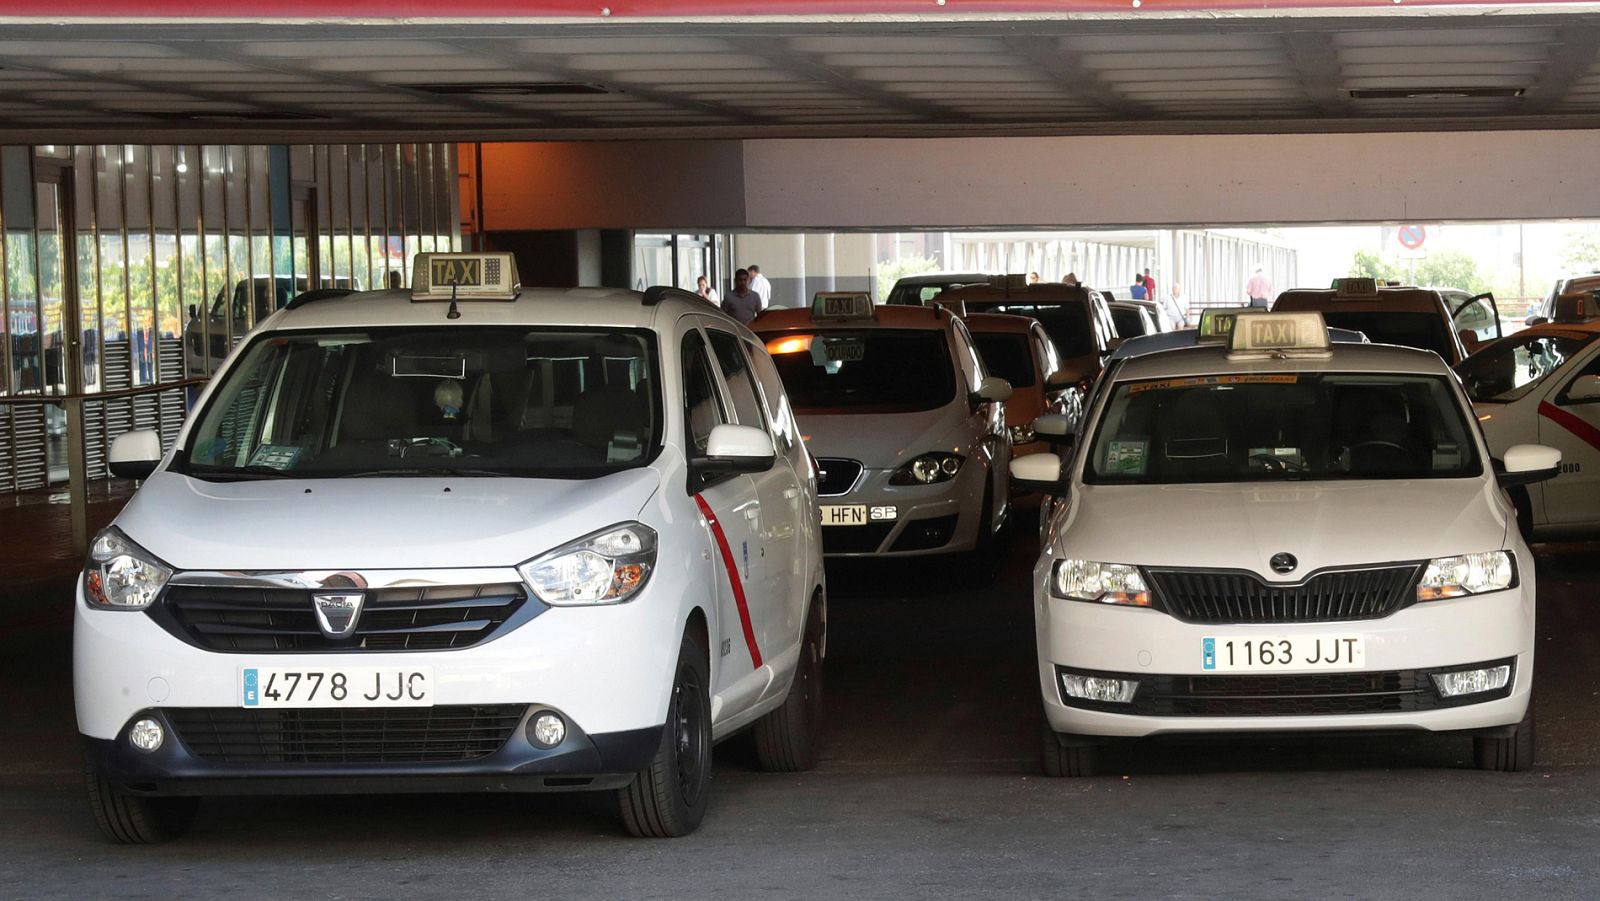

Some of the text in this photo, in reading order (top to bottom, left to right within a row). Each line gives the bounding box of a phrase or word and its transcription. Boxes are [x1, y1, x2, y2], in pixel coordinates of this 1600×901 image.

[432, 260, 479, 285] TAXI
[826, 299, 853, 314] TAXI
[1216, 316, 1232, 333] TA
[1252, 323, 1294, 345] TAXI
[831, 507, 861, 523] HFN
[321, 600, 354, 609] DACIA
[1226, 640, 1293, 666] 1163
[1305, 638, 1358, 664] JJT
[248, 671, 425, 702] E 4778 JJC
